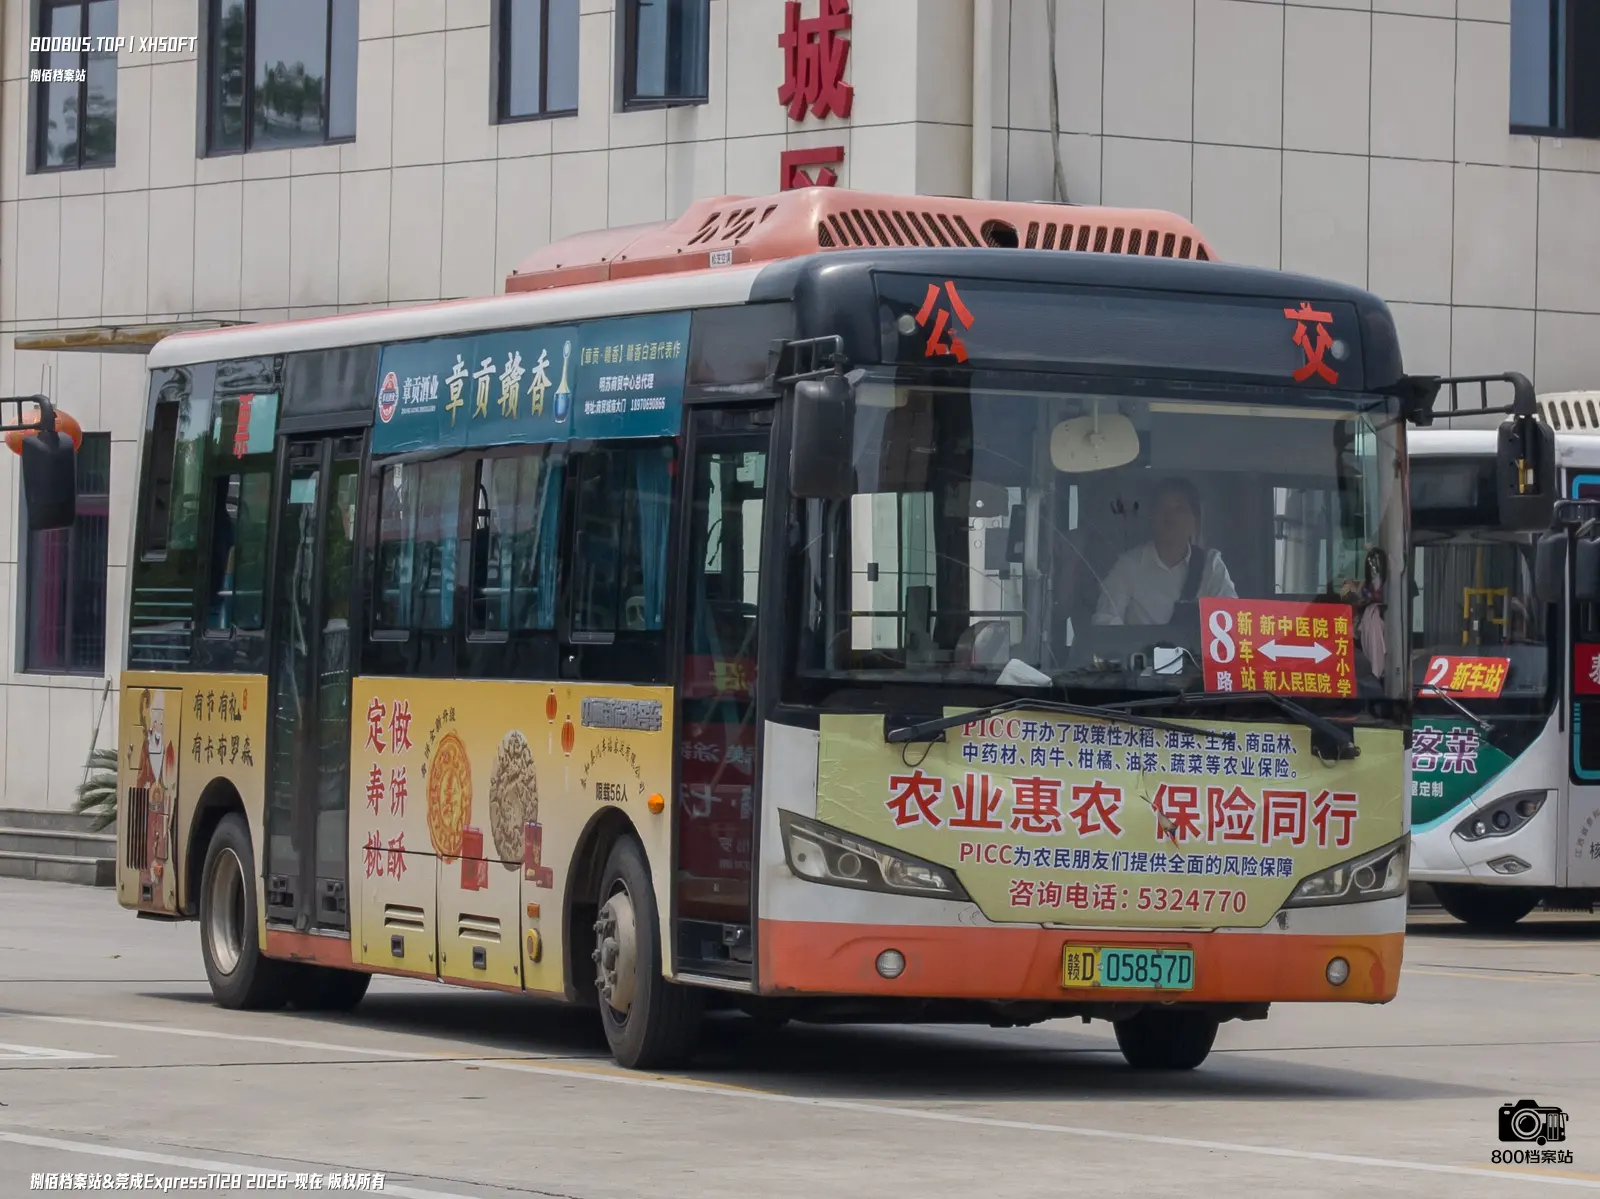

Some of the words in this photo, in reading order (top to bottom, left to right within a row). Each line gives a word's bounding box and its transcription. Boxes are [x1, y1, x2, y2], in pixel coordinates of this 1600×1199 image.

[915, 280, 974, 363] 公
[1284, 302, 1338, 384] 交
[1237, 610, 1257, 692] 新车站
[1259, 614, 1329, 639] 新中医院
[1262, 670, 1333, 694] 新人民医院
[1333, 616, 1353, 698] 南方小学
[1421, 657, 1450, 694] 2
[1449, 662, 1505, 693] 新车站
[364, 695, 413, 756] 定做
[364, 762, 409, 819] 寿饼
[885, 769, 1124, 837] 农业惠农
[1152, 783, 1359, 849] 保险同行
[362, 829, 408, 882] 桃酥
[958, 842, 1294, 878] PICC为农民朋友们提供全面的风险保障
